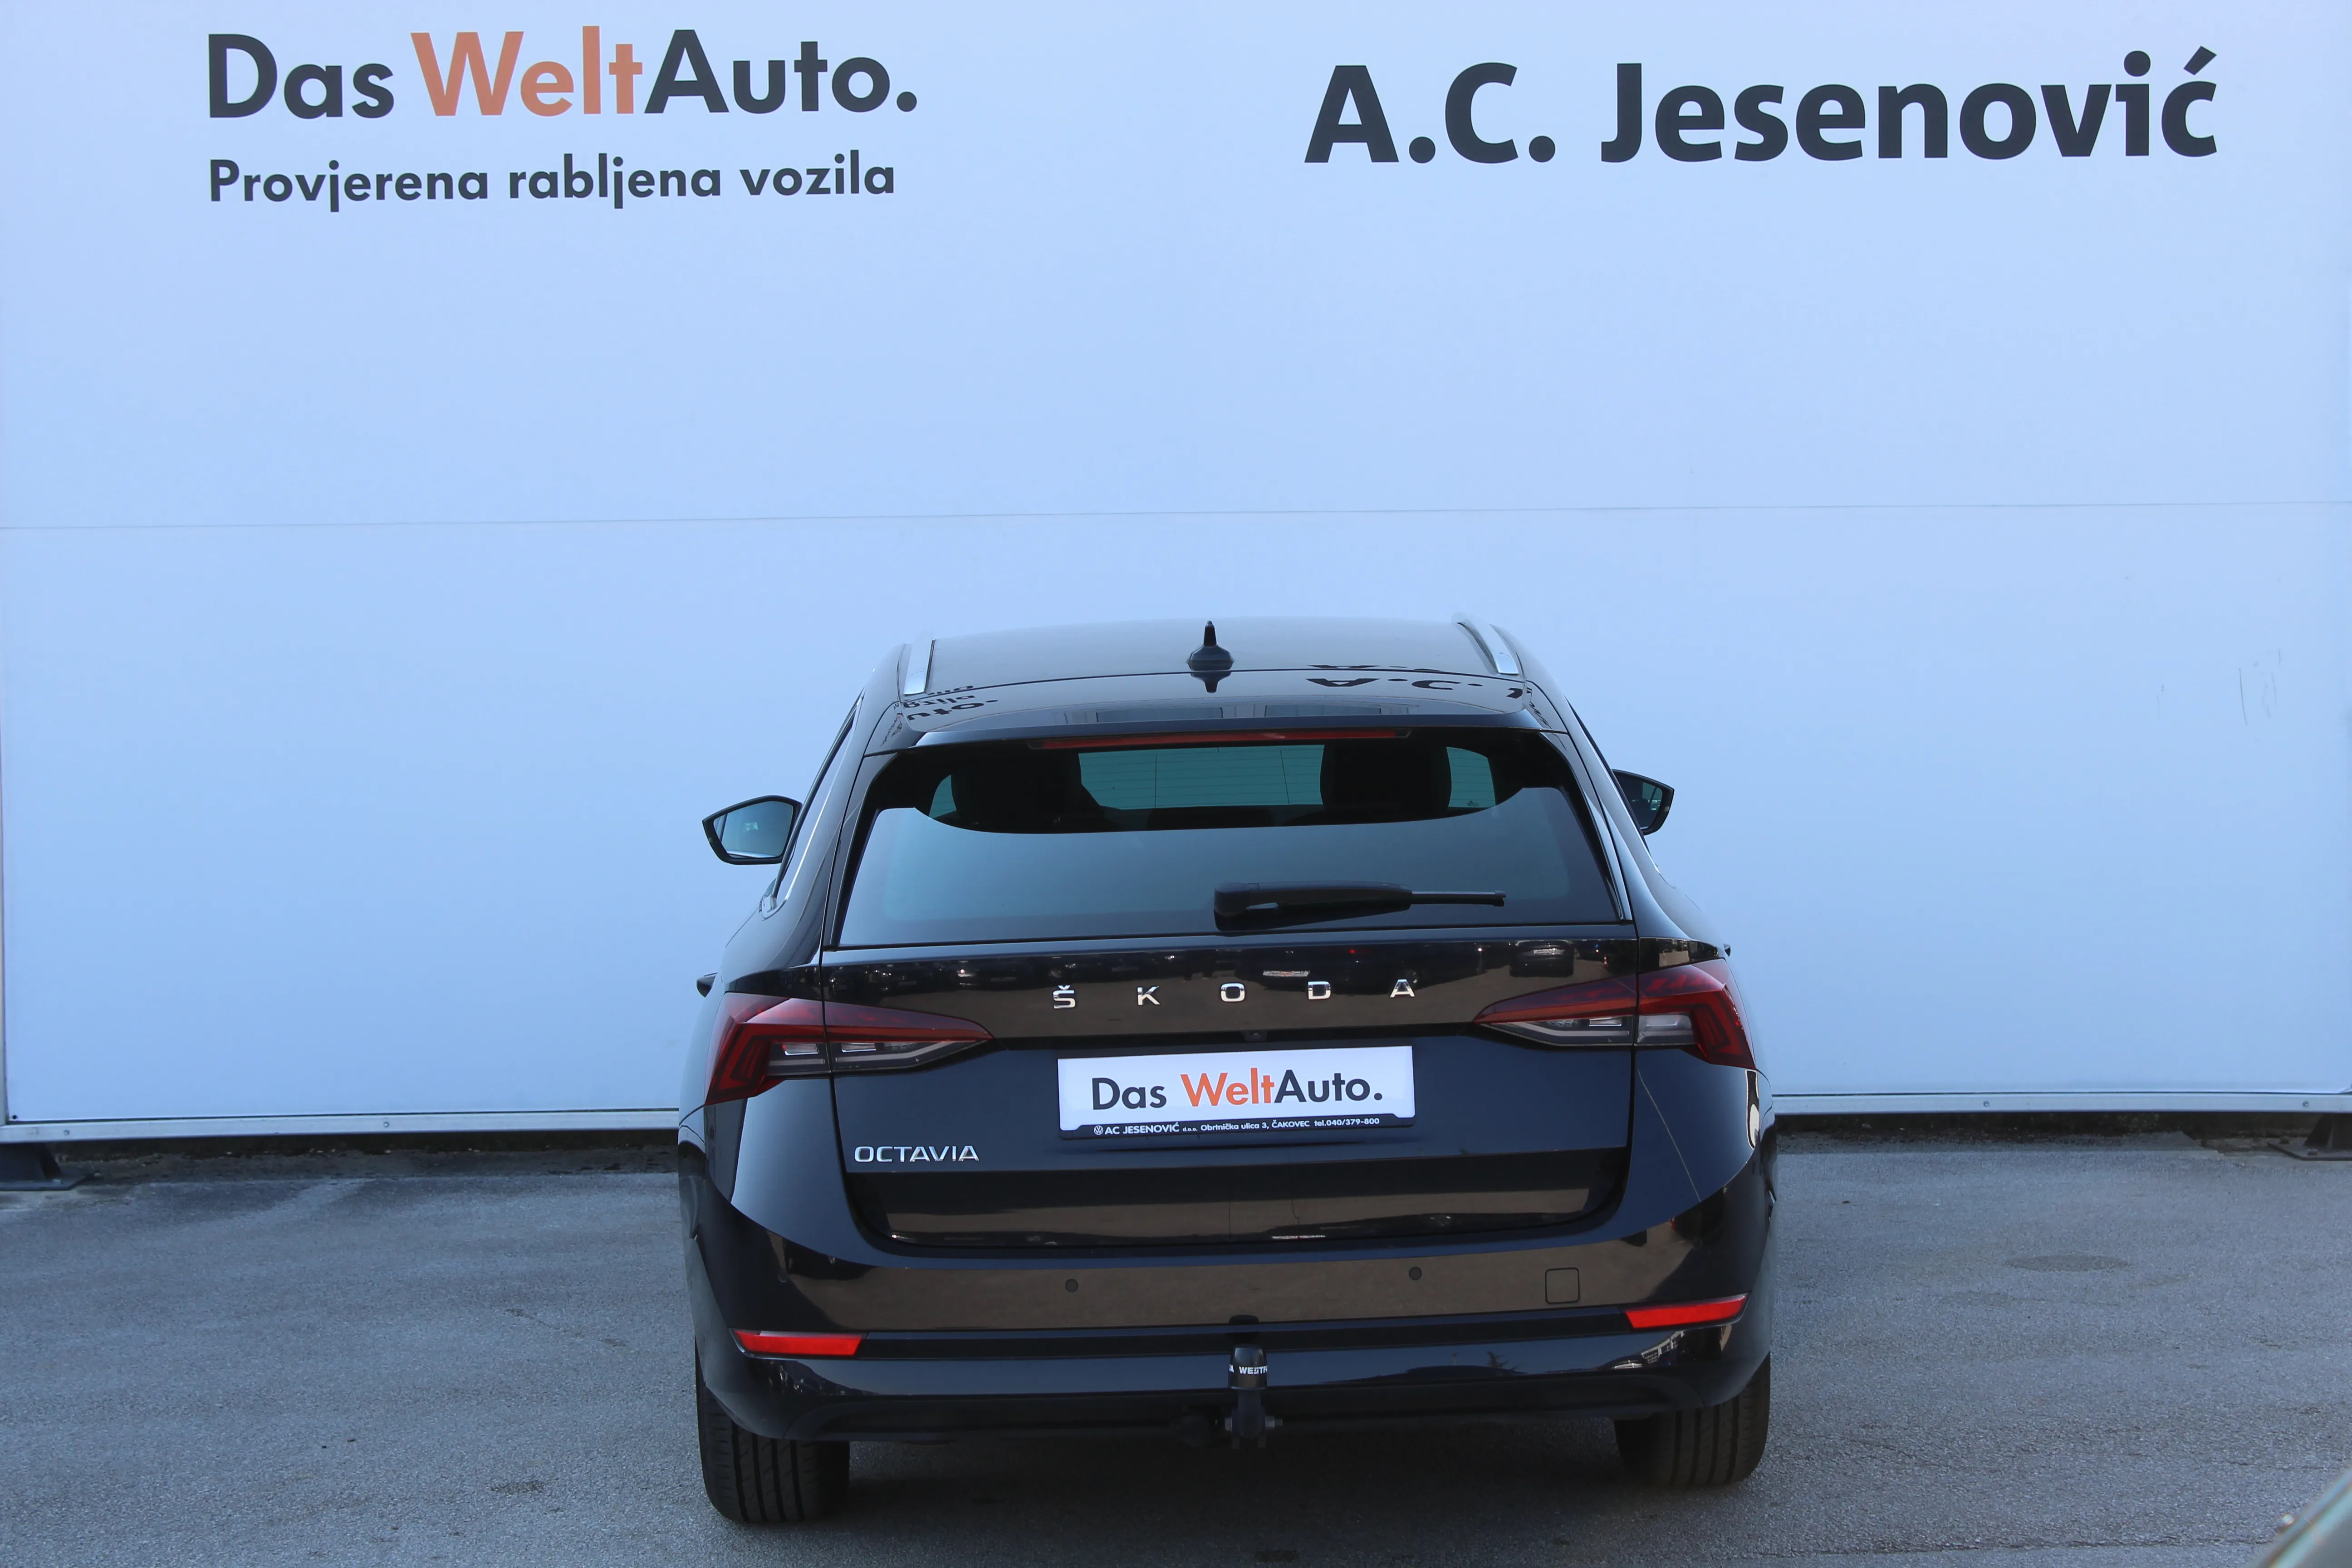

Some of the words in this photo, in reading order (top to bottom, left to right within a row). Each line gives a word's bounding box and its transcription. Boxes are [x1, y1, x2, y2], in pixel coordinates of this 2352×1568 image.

[208, 34, 394, 119] Das
[410, 25, 917, 117] WeltAuto.
[1304, 62, 1556, 164] A.C.
[1601, 46, 2218, 163] Jesenović
[210, 159, 488, 212] Provjerena
[510, 153, 721, 210] rabljena
[739, 149, 894, 197] vozila
[1092, 1077, 1167, 1110] Das
[1180, 1067, 1382, 1107] WeltAuto.
[1104, 1127, 1120, 1135] AC
[1122, 1122, 1180, 1134] JESENOVIĆ
[1200, 1123, 1239, 1131] Obrtnička
[1271, 1119, 1310, 1128] ČAKOVEC
[1314, 1117, 1380, 1127] tel.040/379-800
[854, 1146, 980, 1162] OCTAVIA
